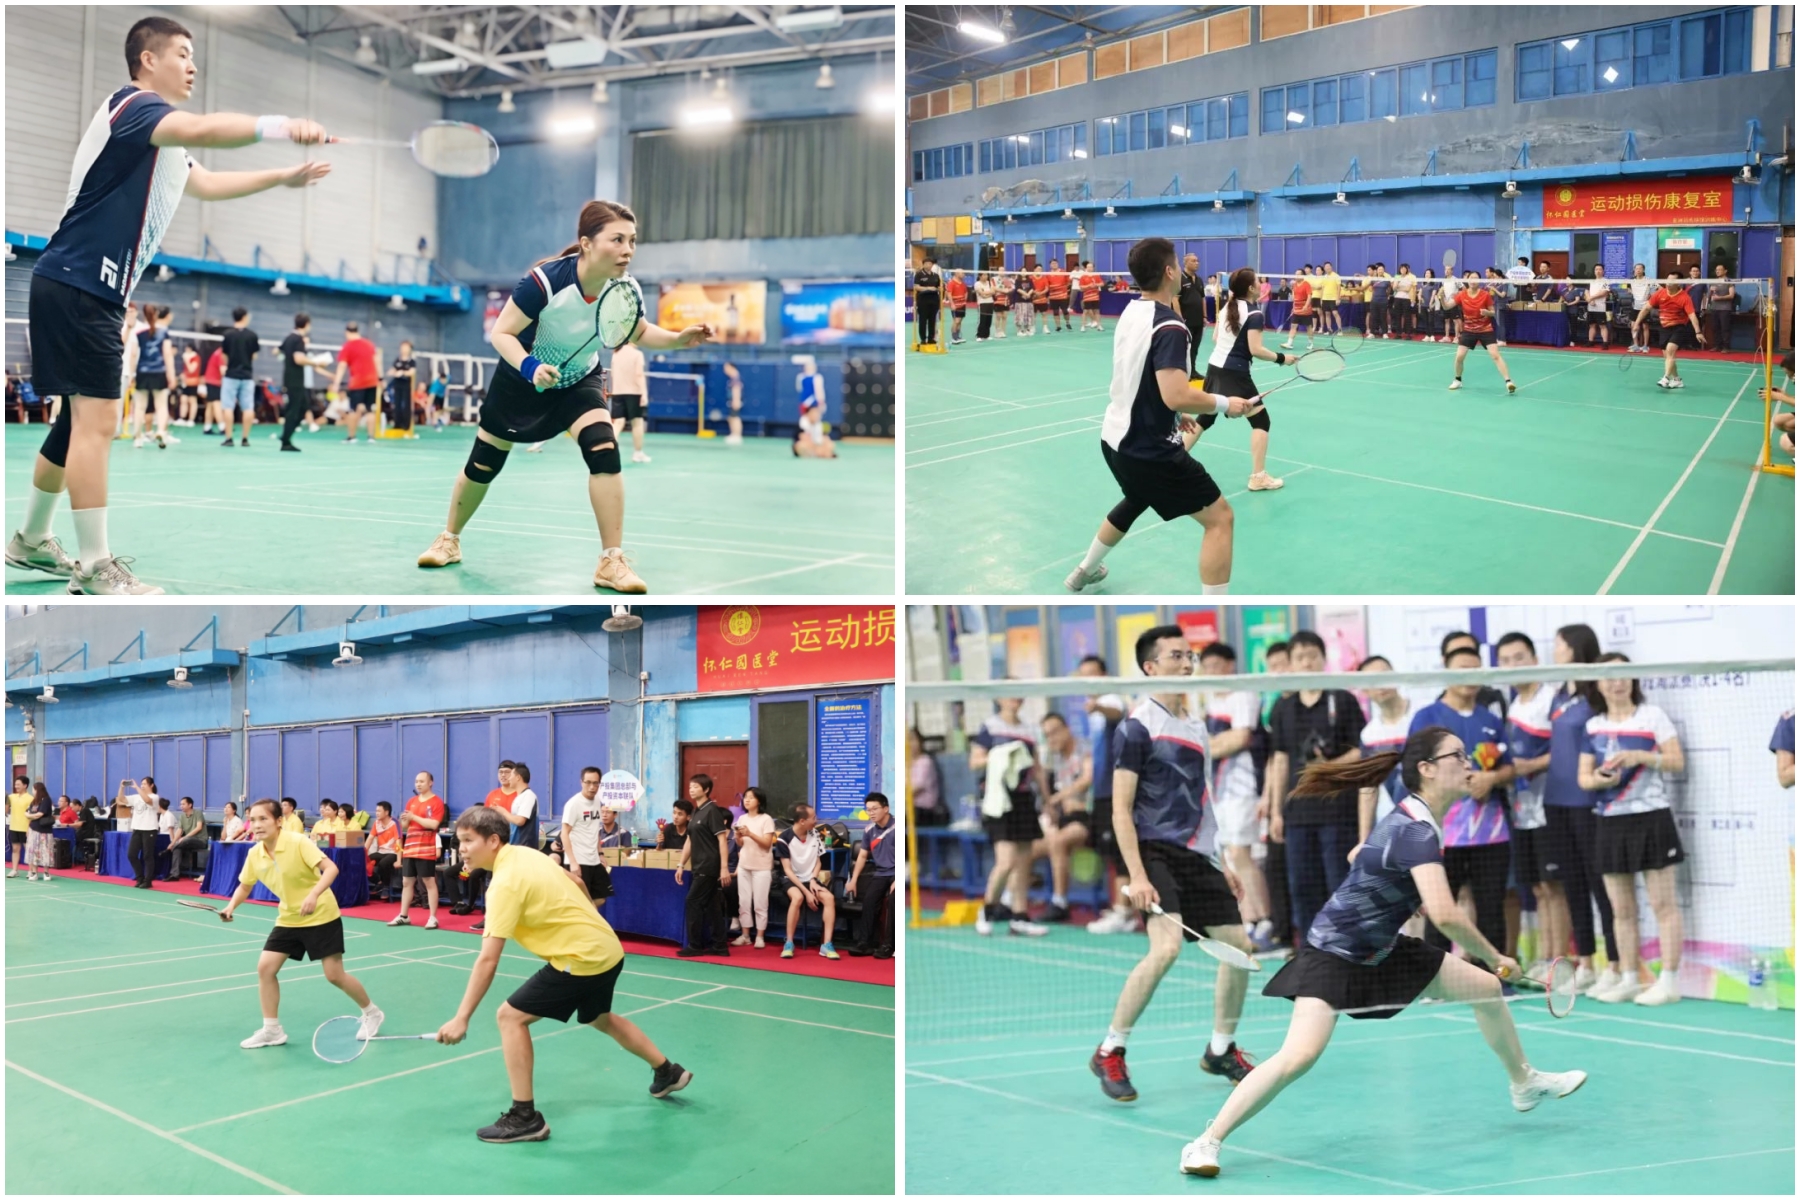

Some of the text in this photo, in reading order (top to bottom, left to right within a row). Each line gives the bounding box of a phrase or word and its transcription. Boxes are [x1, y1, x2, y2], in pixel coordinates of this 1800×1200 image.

[1590, 191, 1722, 213] 运动损伤康复室
[100, 256, 119, 290] 21
[790, 608, 895, 654] 运动损
[583, 810, 600, 821] FILA
